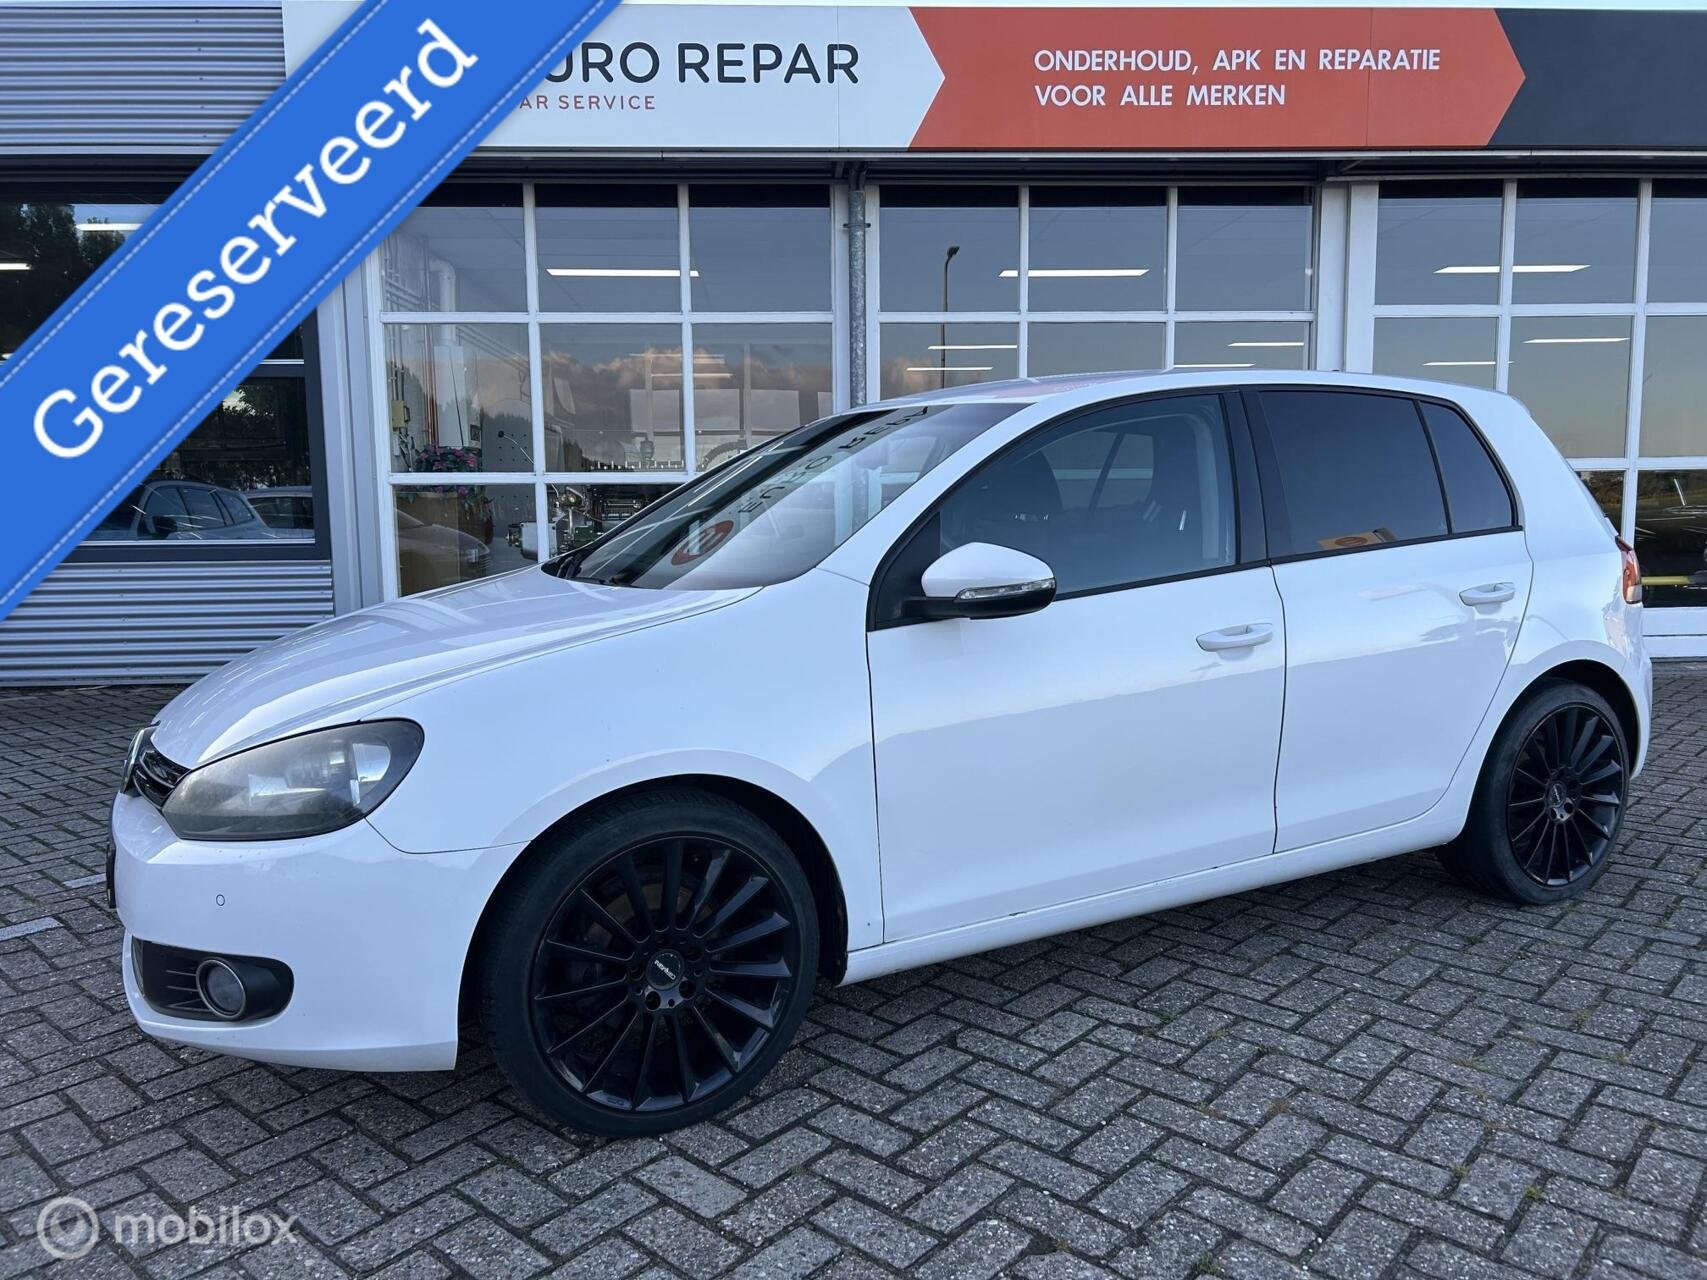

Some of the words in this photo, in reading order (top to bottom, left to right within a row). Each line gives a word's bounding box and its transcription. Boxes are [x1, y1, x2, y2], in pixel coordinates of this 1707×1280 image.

[544, 41, 661, 84] URO
[677, 42, 860, 84] REPAR
[1033, 48, 1200, 75] ONDERHOUD,
[1211, 48, 1263, 71] APK
[1274, 48, 1307, 71] EN
[1318, 48, 1442, 71] REPARATIE
[519, 94, 549, 111] AR
[557, 94, 657, 111] SERVICE
[1033, 84, 1108, 107] VOOR
[1119, 84, 1174, 106] ALLE
[1186, 84, 1287, 106] MERKEN
